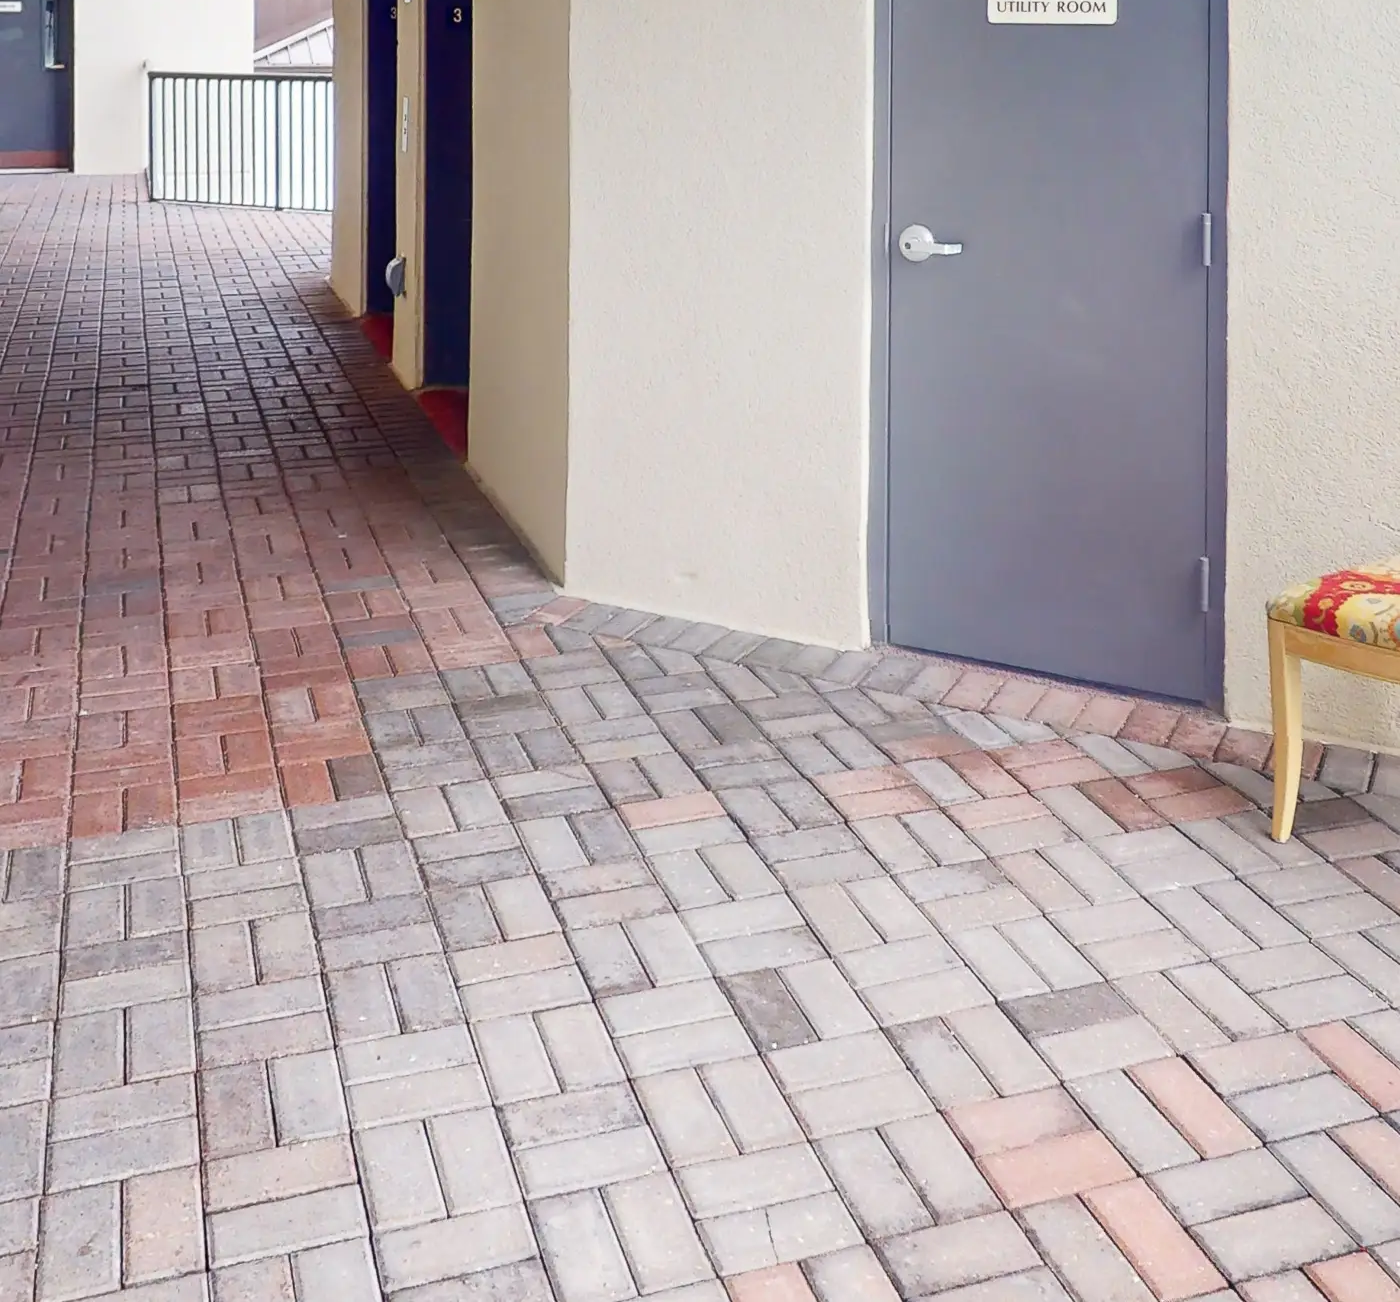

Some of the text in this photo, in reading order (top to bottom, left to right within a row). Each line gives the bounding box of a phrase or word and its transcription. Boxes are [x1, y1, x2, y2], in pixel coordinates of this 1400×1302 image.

[389, 6, 397, 20] 3
[996, 0, 1107, 13] UTILITY ROOM
[453, 7, 462, 23] 3
